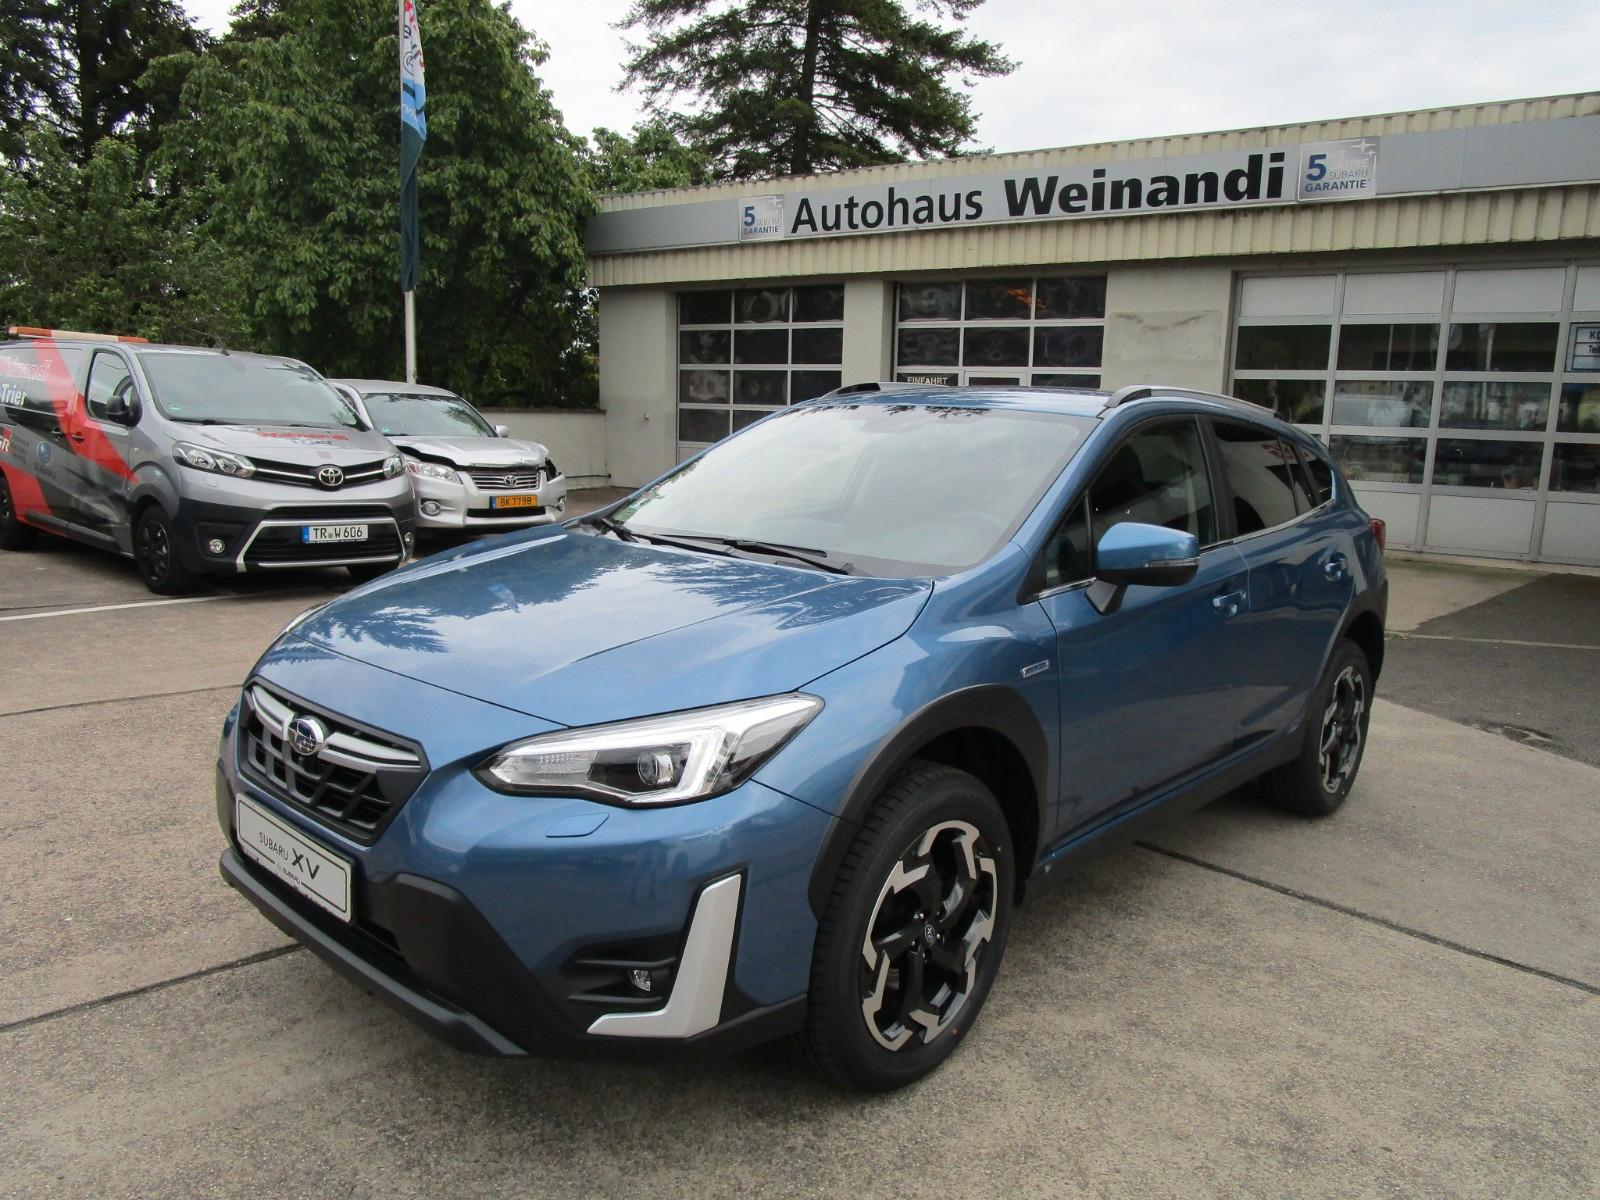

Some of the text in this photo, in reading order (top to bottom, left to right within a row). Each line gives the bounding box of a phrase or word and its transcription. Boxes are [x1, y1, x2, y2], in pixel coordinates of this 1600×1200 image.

[1306, 153, 1327, 181] 5
[1329, 168, 1369, 181] SUBARU
[791, 152, 1286, 234] Autohaus Weinandi
[743, 206, 756, 227] 5
[743, 225, 780, 236] GARANTIE
[907, 376, 948, 385] EINFAHRT
[1, 383, 27, 407] Trier
[258, 831, 290, 861] SUBARU
[291, 847, 321, 880] XV
